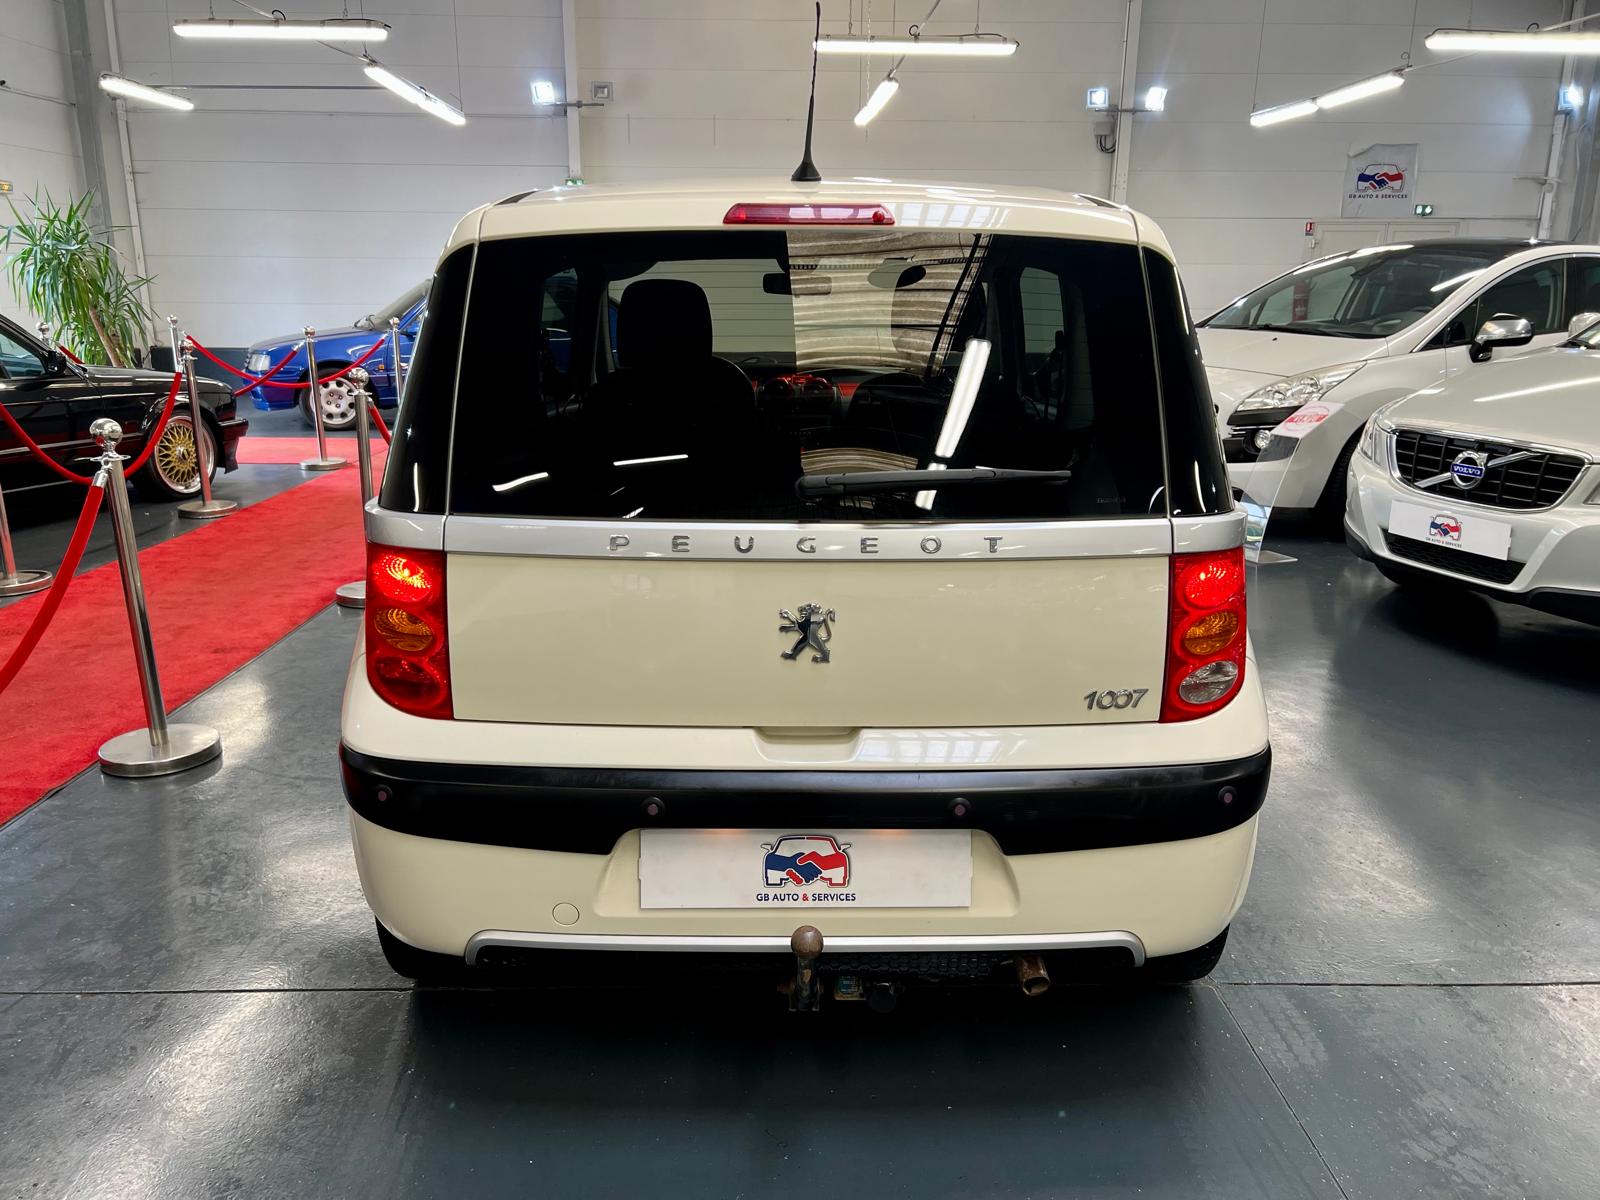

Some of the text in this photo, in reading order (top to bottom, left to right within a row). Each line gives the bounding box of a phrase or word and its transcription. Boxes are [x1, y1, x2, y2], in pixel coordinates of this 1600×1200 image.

[1453, 465, 1481, 475] VOLVO
[609, 534, 1003, 554] PEUGEOT
[1083, 688, 1149, 711] 1007
[756, 893, 857, 902] GB AUTO & SERVICES
